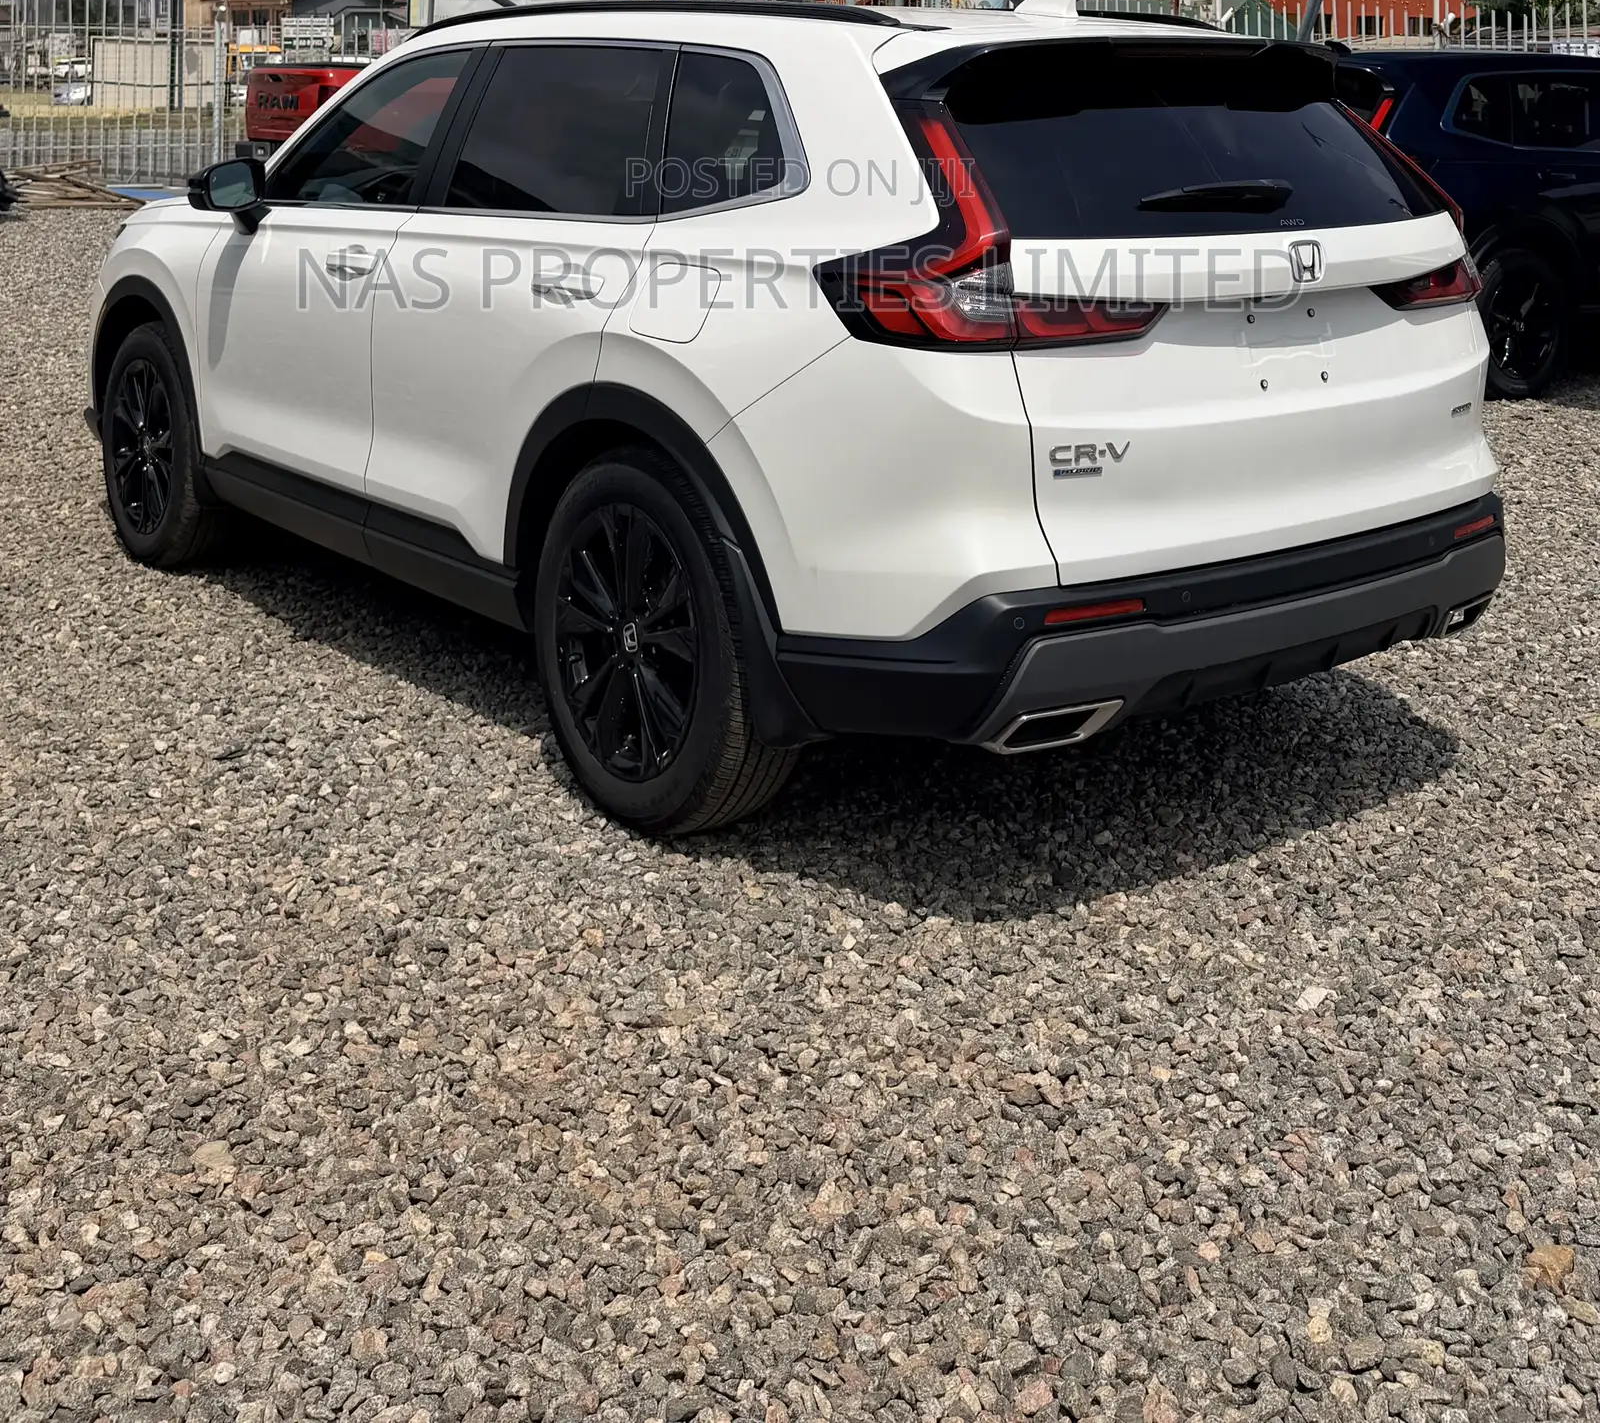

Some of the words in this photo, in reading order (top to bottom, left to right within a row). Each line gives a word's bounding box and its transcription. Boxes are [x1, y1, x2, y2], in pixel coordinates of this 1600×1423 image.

[257, 92, 298, 110] RAM
[1280, 218, 1305, 226] AWD
[1049, 441, 1130, 467] CR-V
